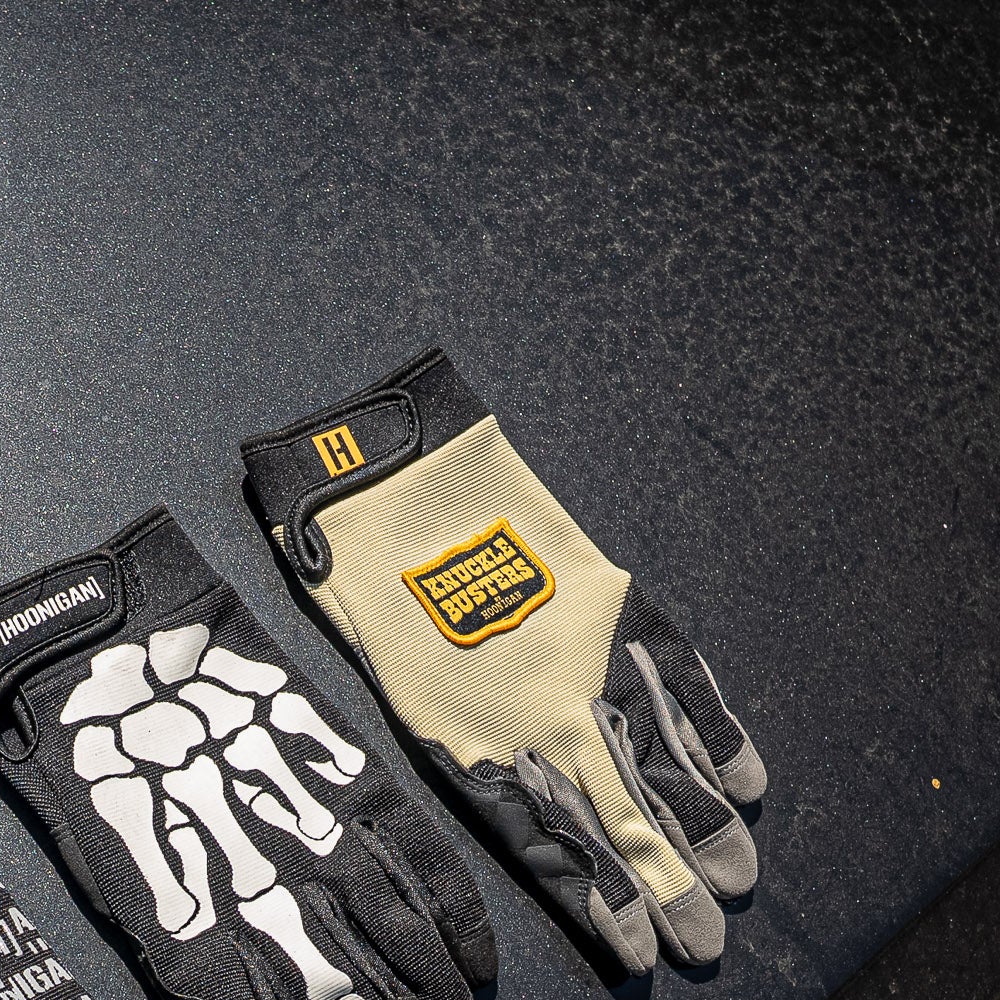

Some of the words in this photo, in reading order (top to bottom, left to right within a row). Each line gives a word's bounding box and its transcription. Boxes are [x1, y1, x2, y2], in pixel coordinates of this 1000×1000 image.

[420, 536, 517, 600] KNUCKLE
[439, 556, 536, 625] BUSTERS
[480, 590, 524, 620] HOONIGAN
